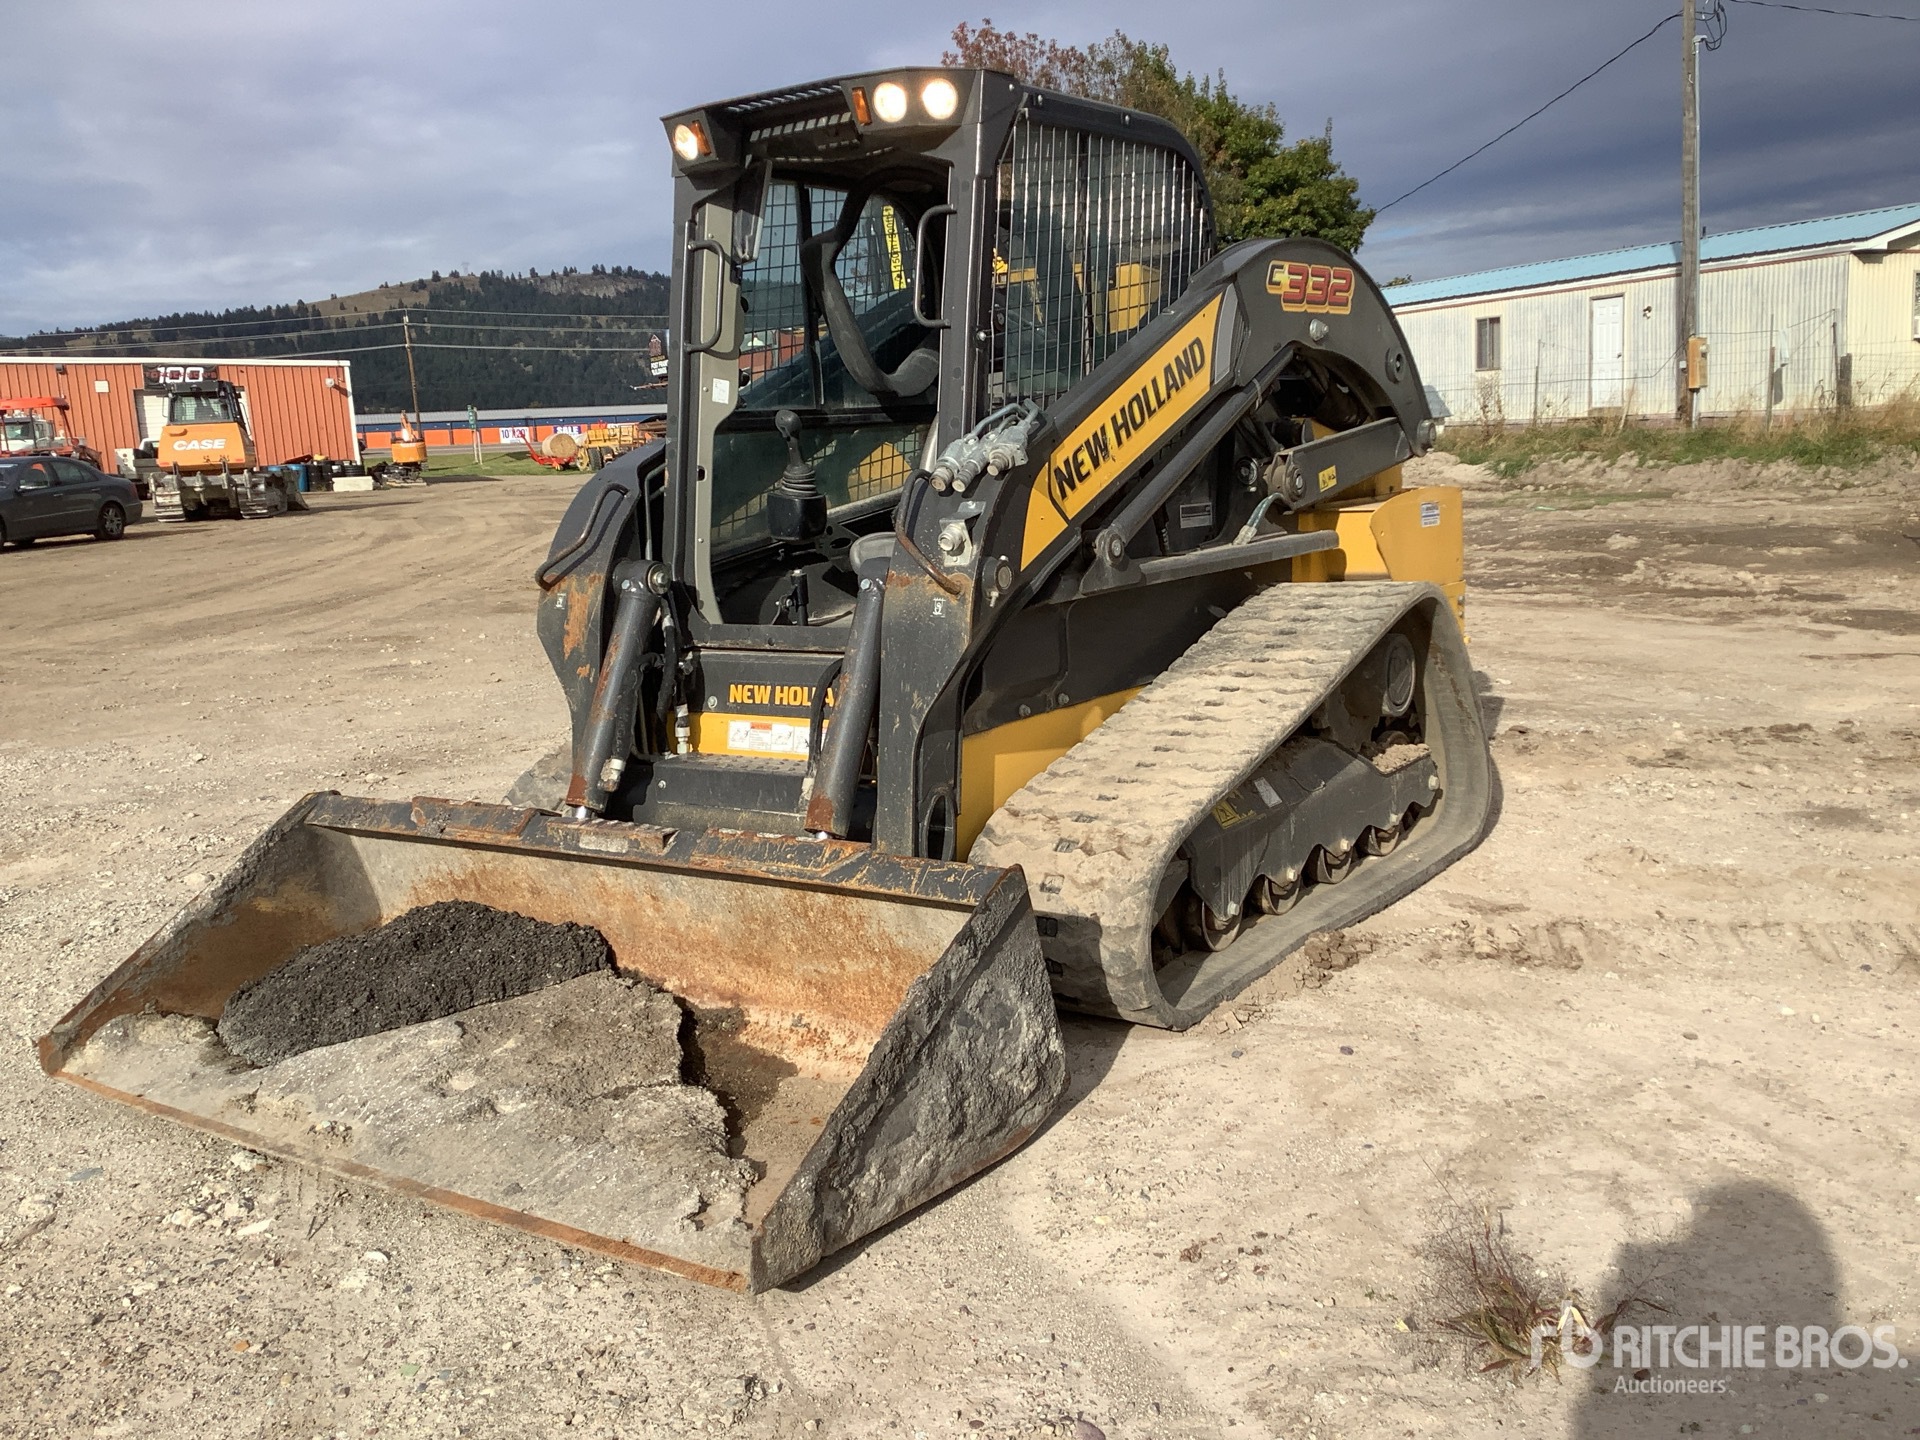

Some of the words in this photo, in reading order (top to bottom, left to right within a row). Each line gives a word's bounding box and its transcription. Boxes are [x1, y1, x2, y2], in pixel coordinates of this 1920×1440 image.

[157, 366, 204, 383] 100
[1053, 423, 1111, 501] NEW
[1110, 336, 1206, 448] HOLLAND
[556, 426, 579, 434] SALE
[173, 439, 226, 450] CASE
[729, 684, 771, 704] NEW
[775, 686, 834, 707] HOLA
